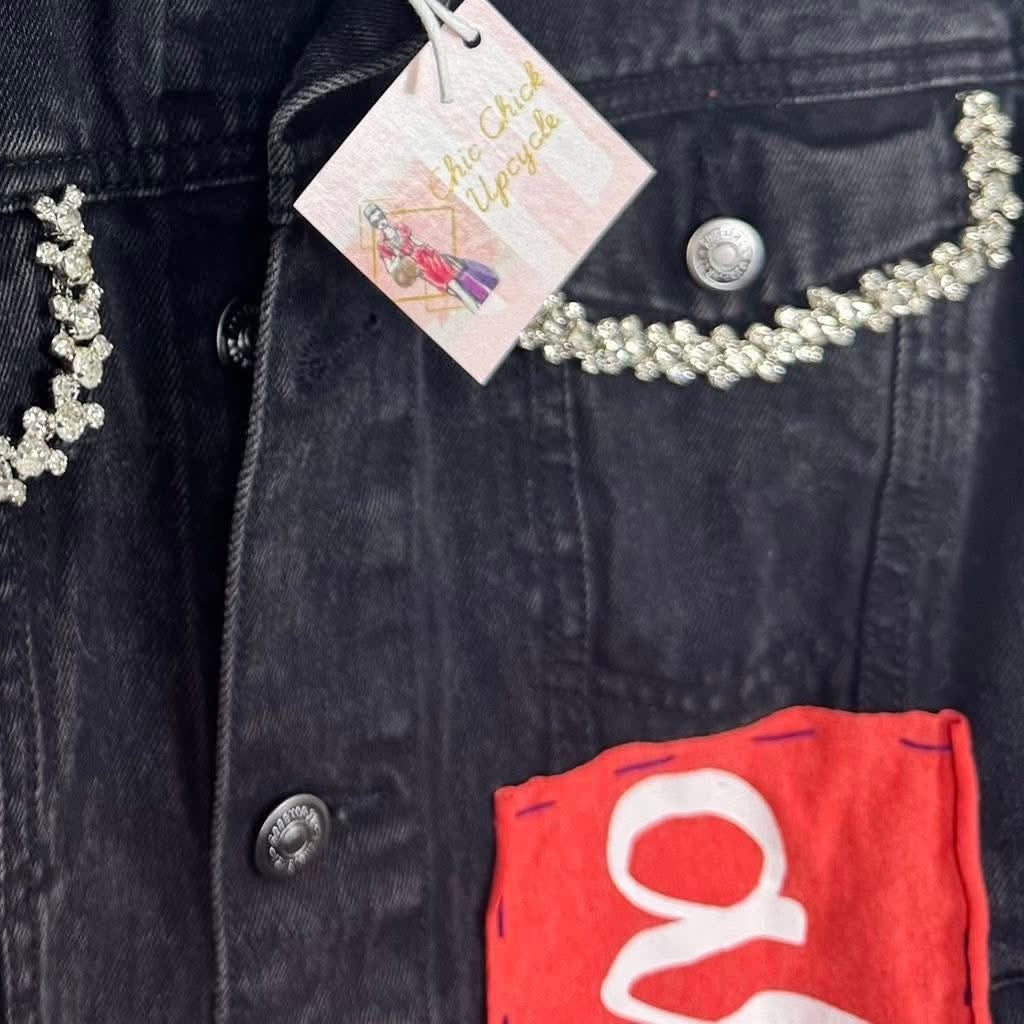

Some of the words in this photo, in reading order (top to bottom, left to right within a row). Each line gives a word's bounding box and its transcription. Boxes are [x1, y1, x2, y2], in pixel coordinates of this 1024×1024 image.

[429, 143, 482, 201] Chic
[479, 60, 544, 140] Chick
[465, 108, 560, 213] Upcycle
